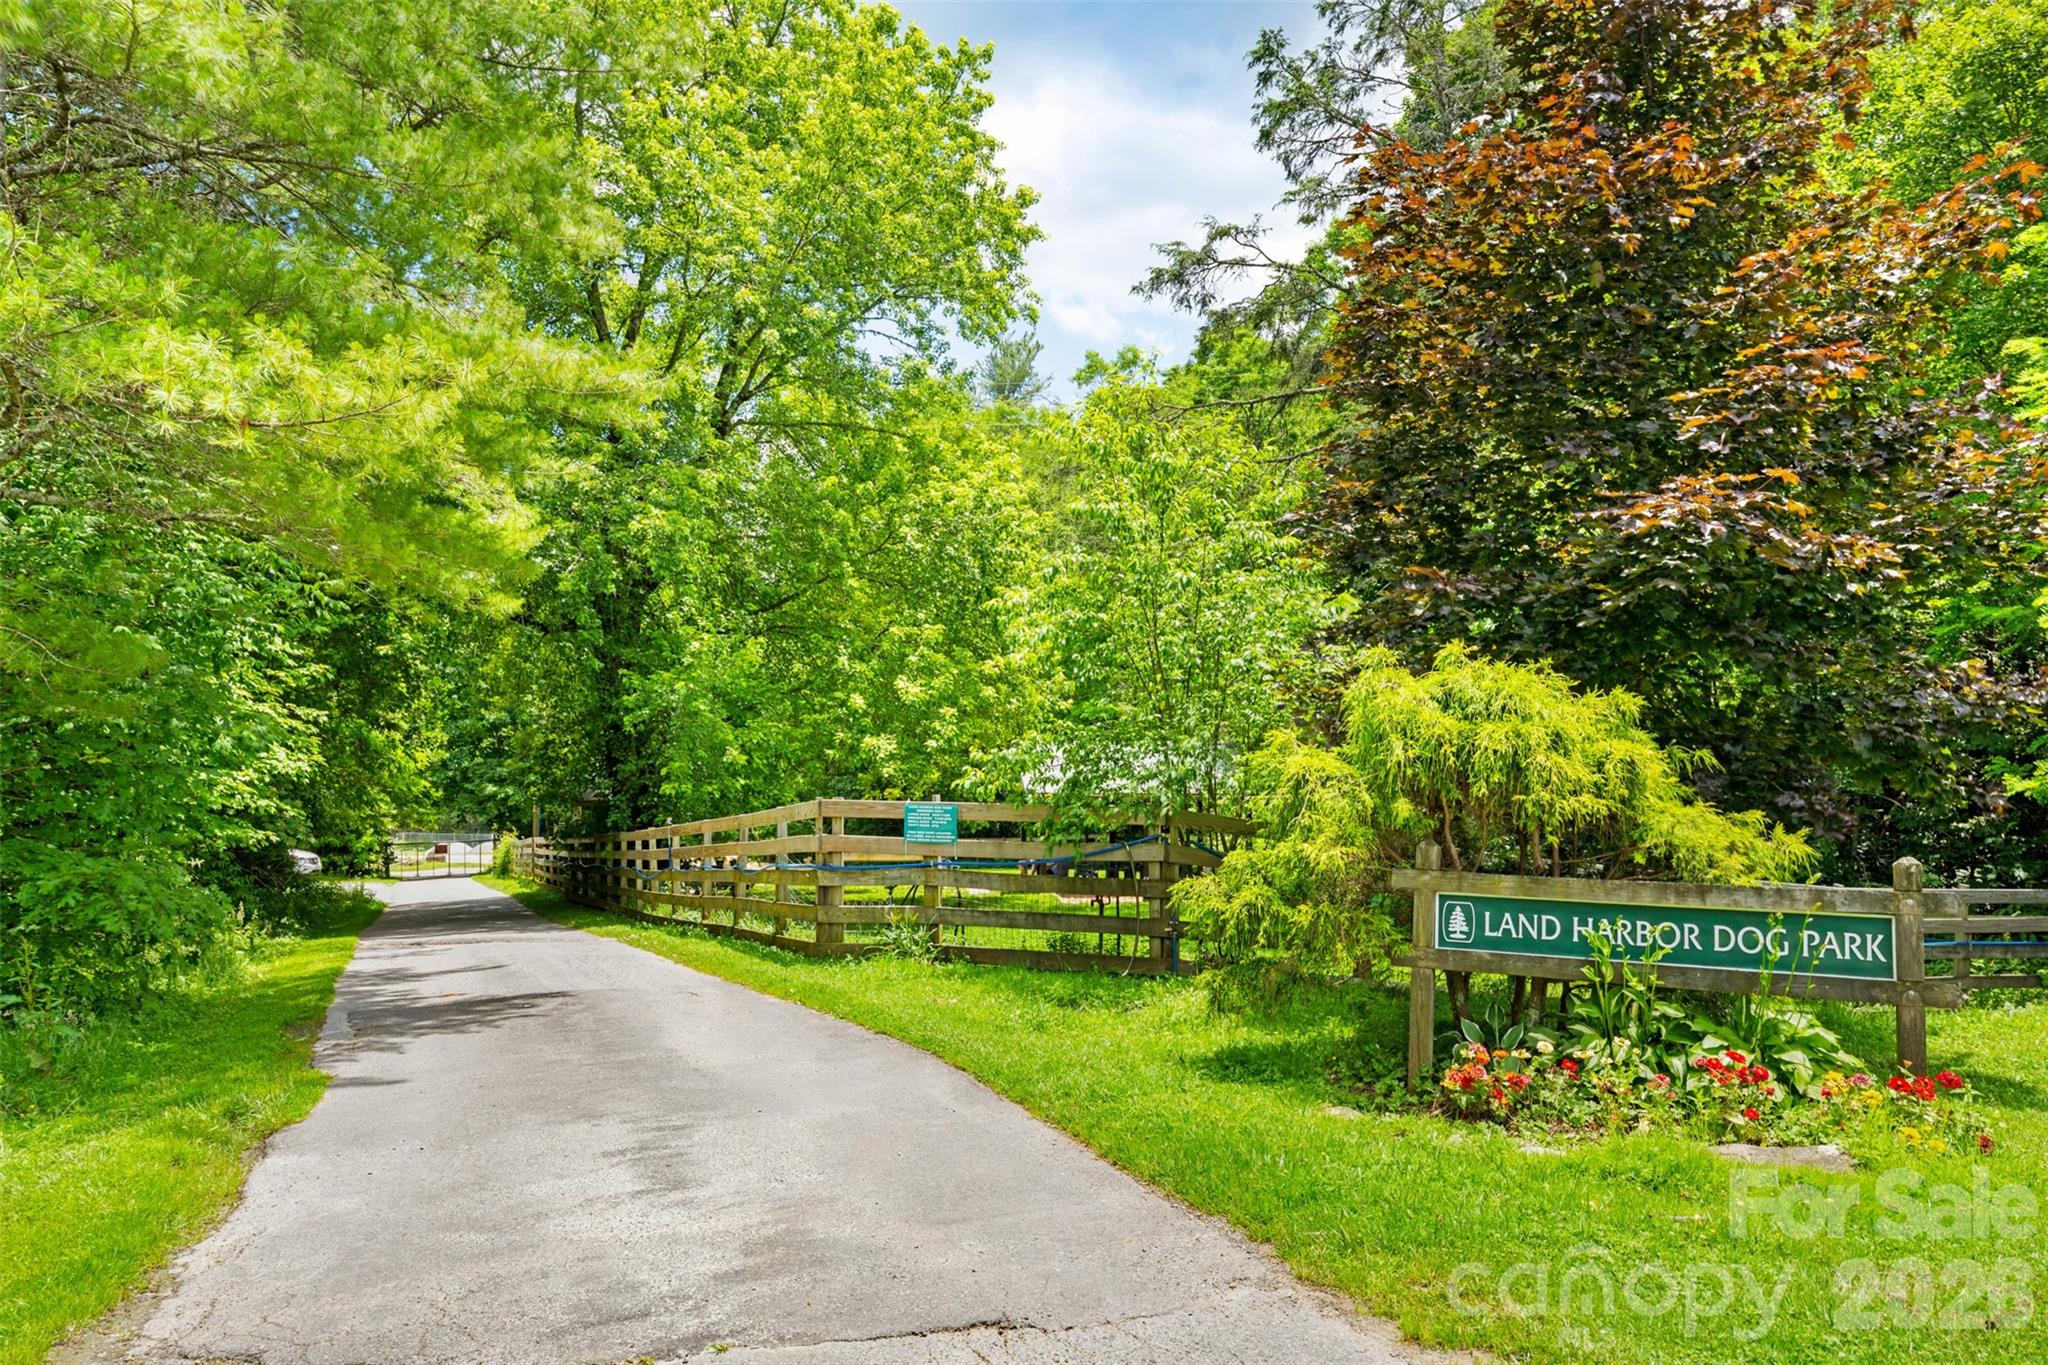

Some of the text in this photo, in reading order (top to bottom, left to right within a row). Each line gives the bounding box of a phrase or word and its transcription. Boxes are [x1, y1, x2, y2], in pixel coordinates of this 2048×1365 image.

[1484, 911, 1887, 963] LAND HARBOR DOG PARK
